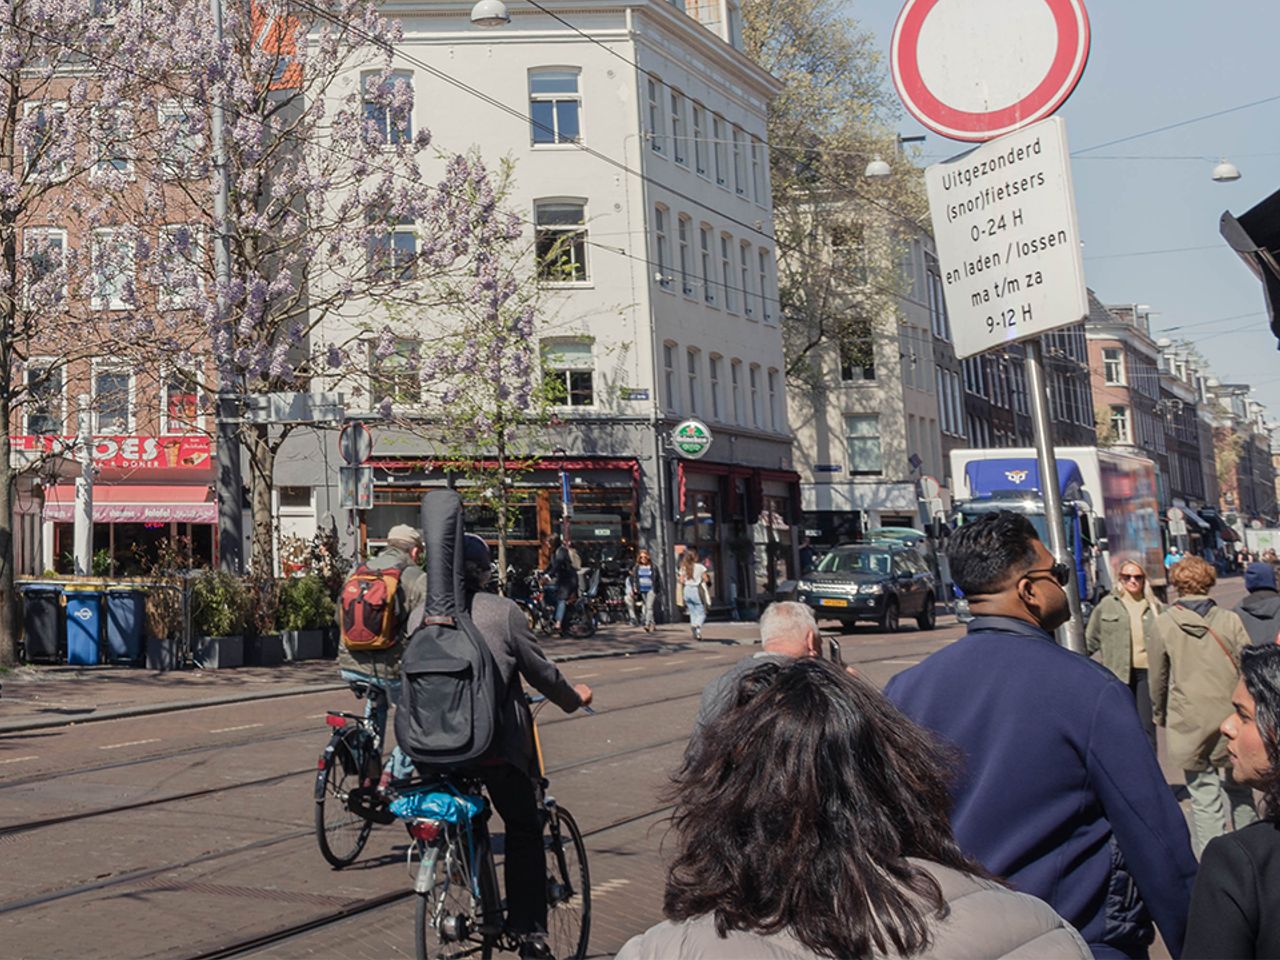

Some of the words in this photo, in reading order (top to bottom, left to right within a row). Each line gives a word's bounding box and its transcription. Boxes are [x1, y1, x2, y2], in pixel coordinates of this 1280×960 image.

[942, 137, 1042, 191] Uitgezonderd
[946, 171, 1045, 223] (snor)fietsers
[970, 215, 1007, 242] 0-24
[1012, 208, 1024, 227] H
[946, 267, 960, 285] en
[963, 251, 1001, 280] laden
[1016, 229, 1067, 259] lossen
[971, 288, 990, 307] ma
[994, 276, 1020, 299] t/m
[1026, 270, 1043, 287] za
[986, 309, 1017, 334] 9-12
[1022, 303, 1033, 321] H
